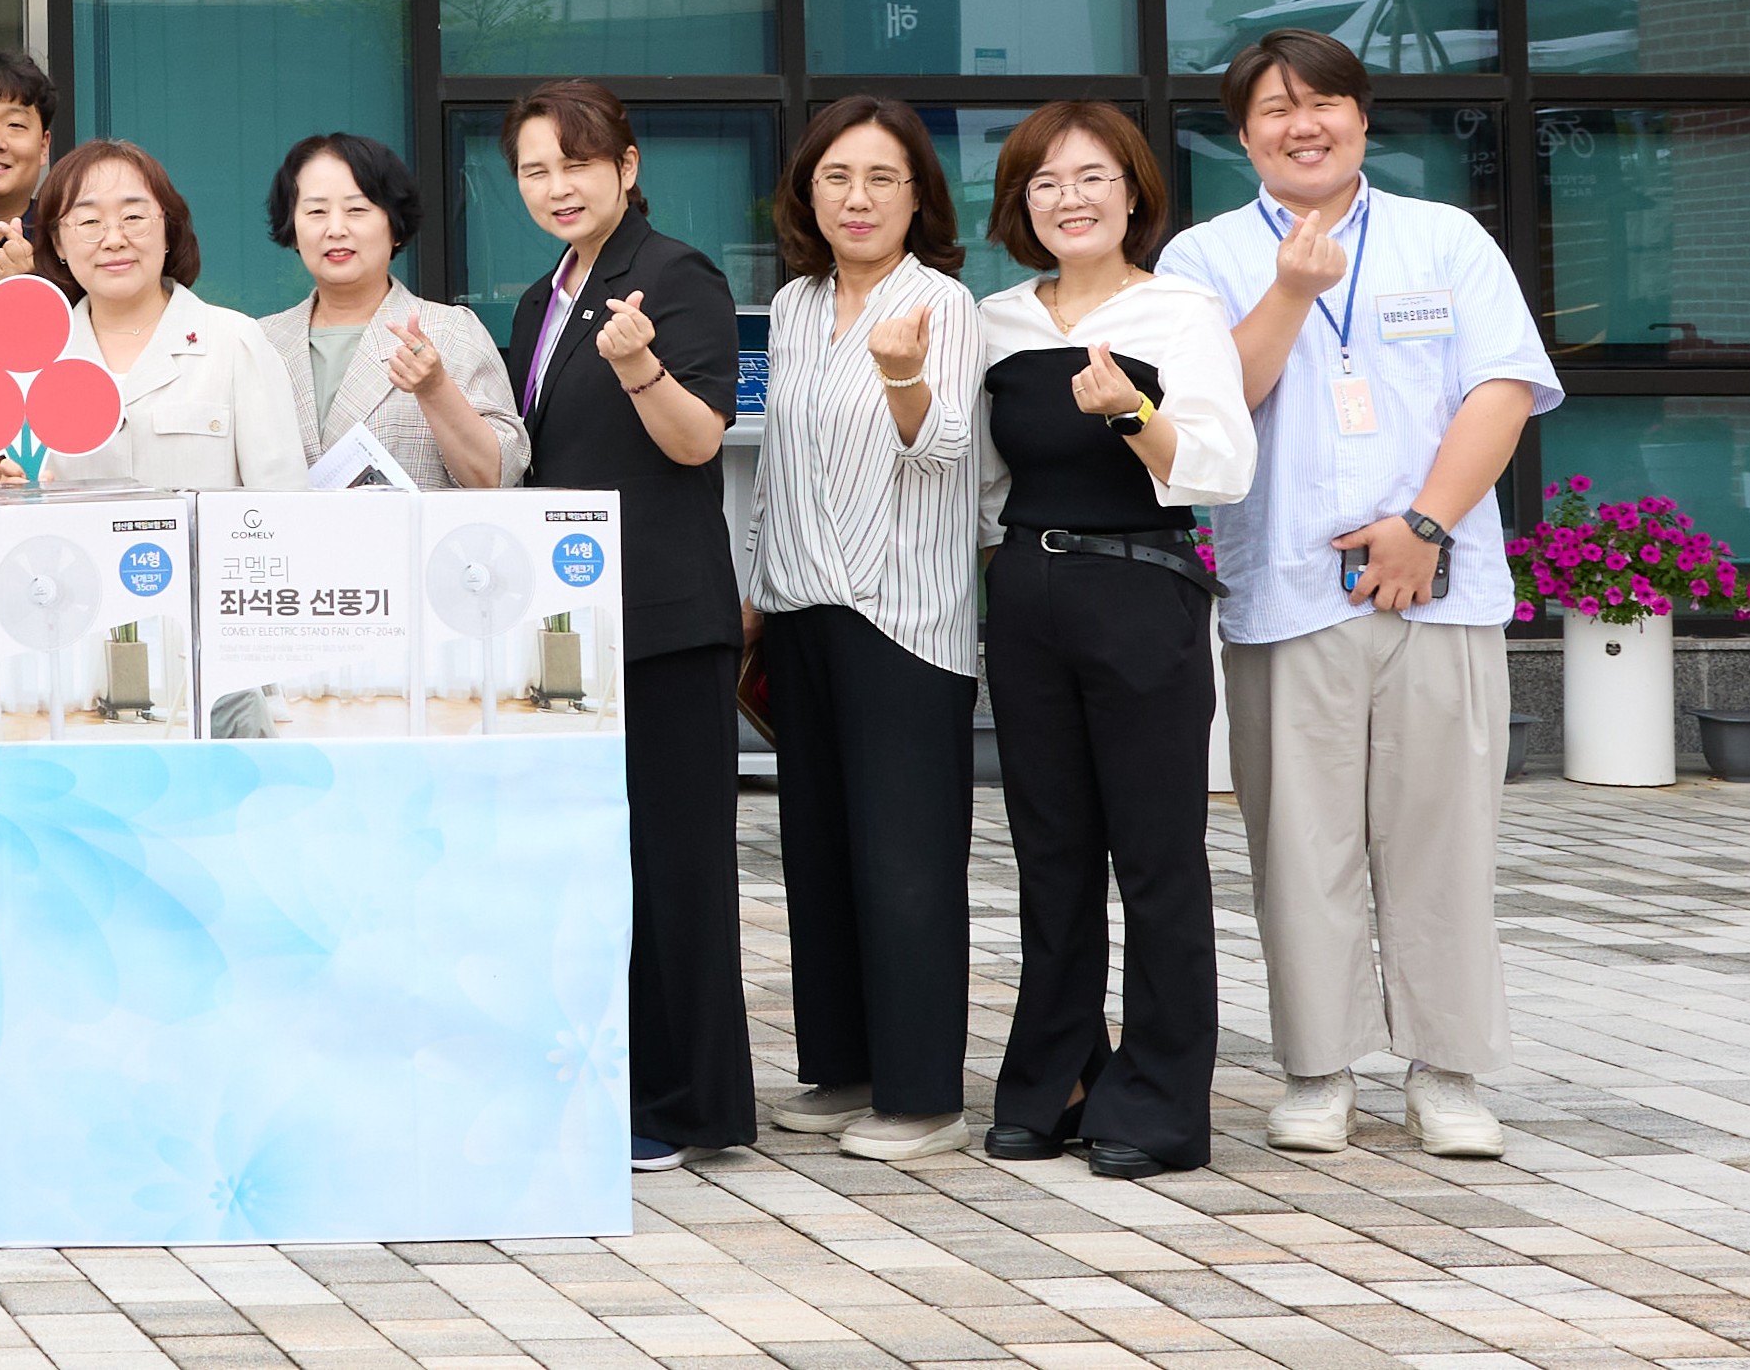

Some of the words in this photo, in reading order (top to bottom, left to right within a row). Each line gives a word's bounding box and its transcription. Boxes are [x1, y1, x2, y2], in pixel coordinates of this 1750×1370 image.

[563, 542, 592, 558] 14형
[130, 552, 160, 568] 14형
[221, 556, 288, 583] 코멜리
[136, 583, 158, 591] 35cm
[220, 589, 300, 616] 좌석용
[310, 589, 389, 616] 선풍기
[259, 627, 299, 636] ELECTRIC
[301, 627, 330, 636] STAND
[332, 627, 349, 636] FAN
